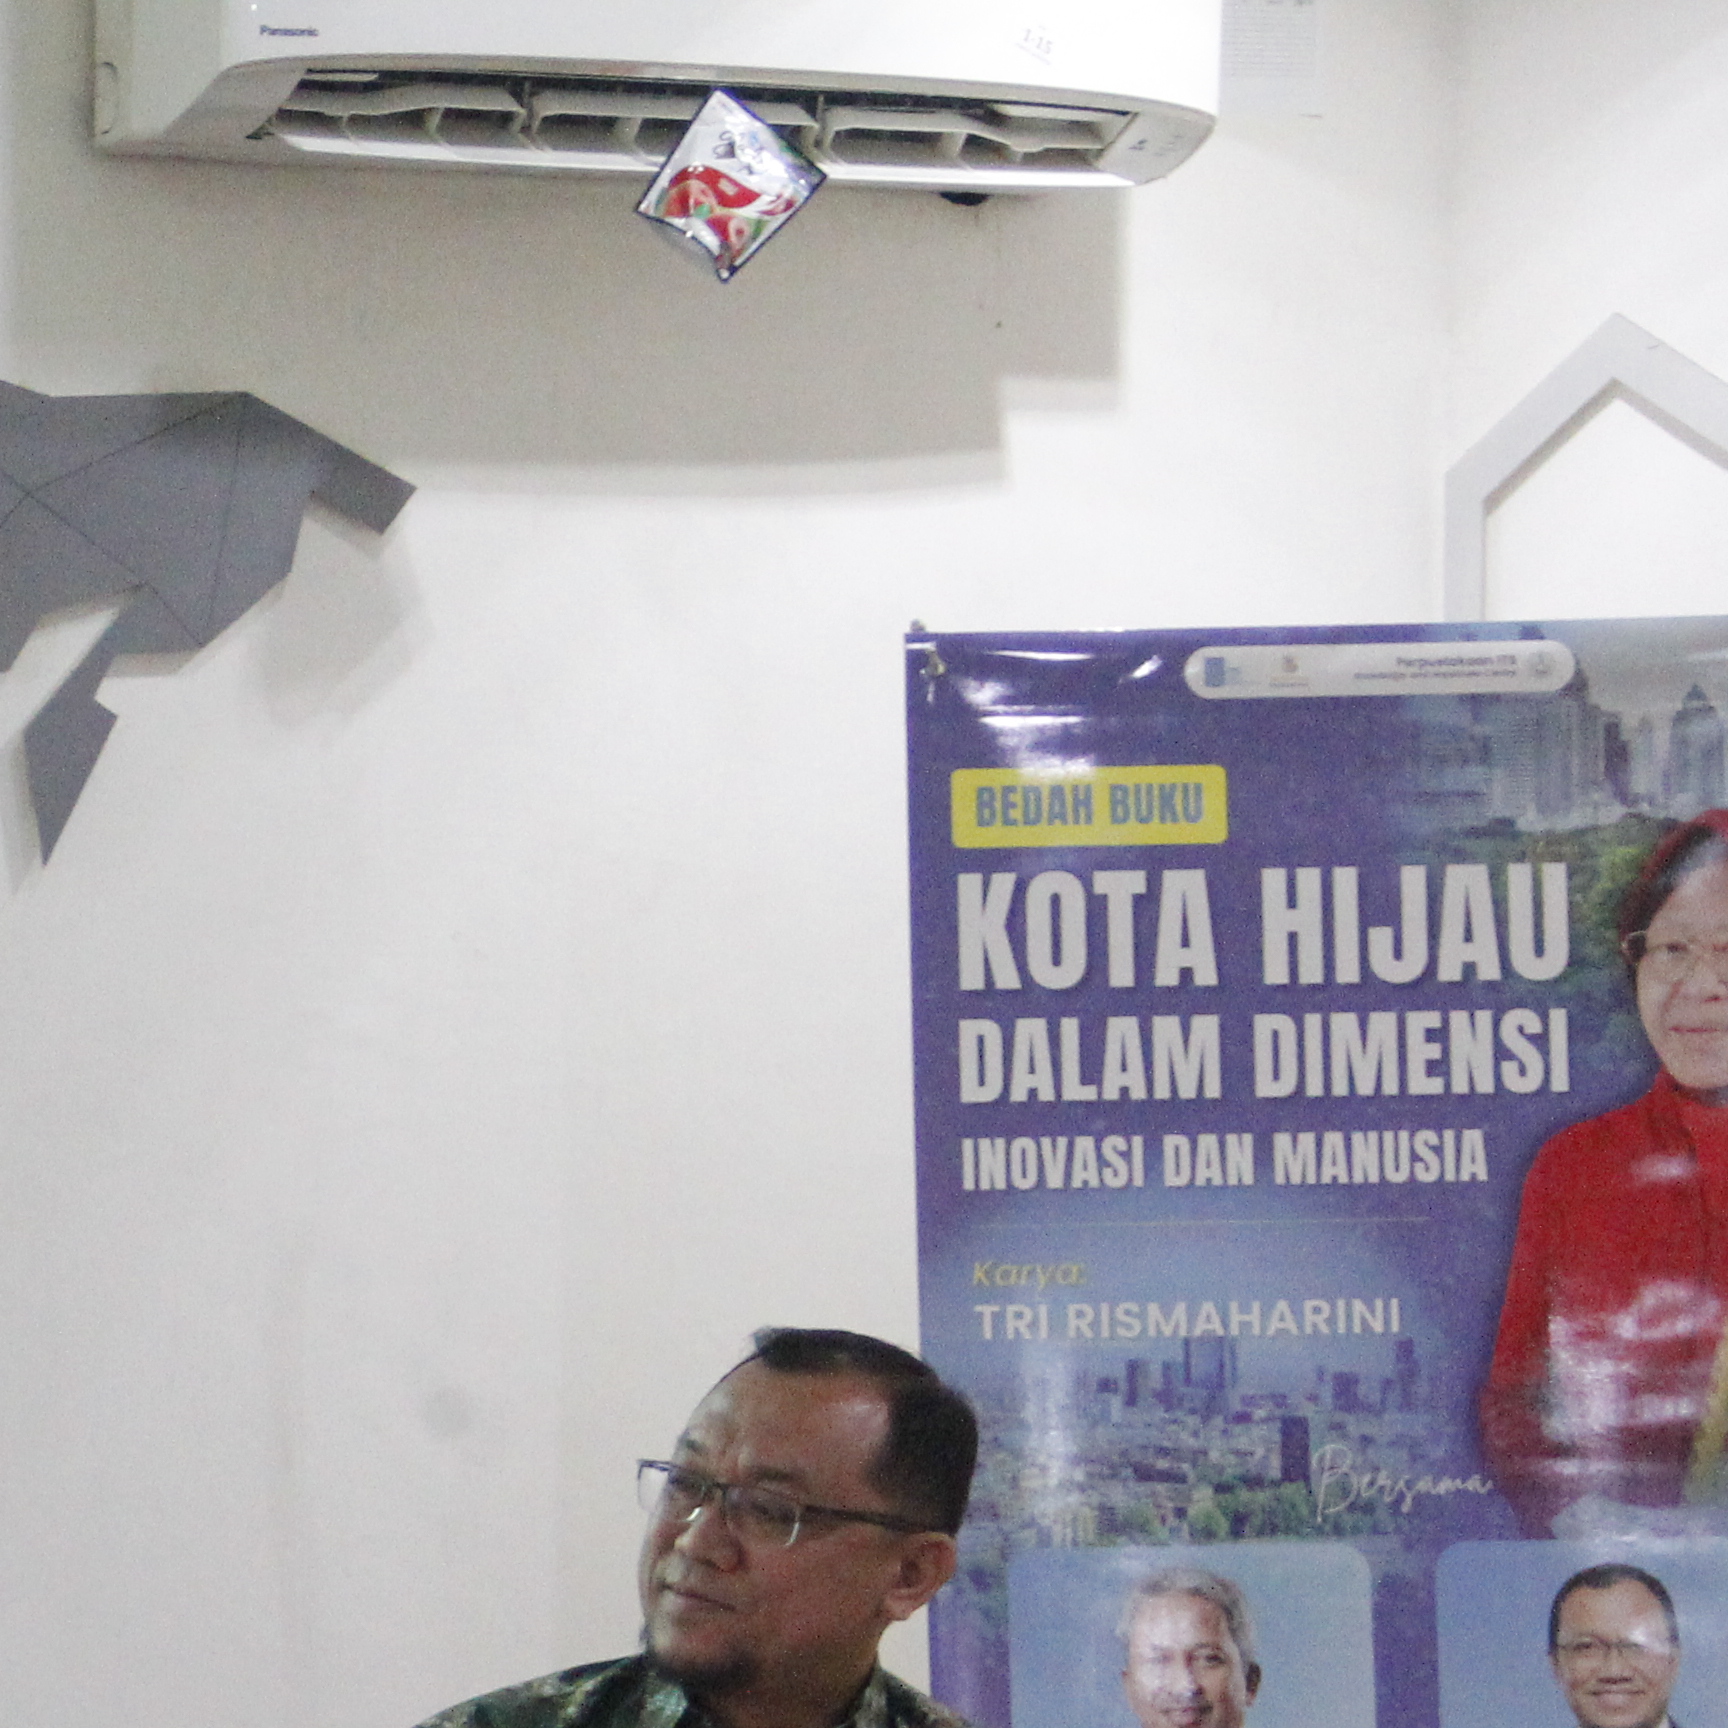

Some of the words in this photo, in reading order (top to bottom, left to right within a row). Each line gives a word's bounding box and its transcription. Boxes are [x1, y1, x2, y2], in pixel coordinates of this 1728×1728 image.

[976, 784, 1093, 827] BEDAH
[1109, 782, 1204, 825] BUKU
[957, 868, 1219, 991] KOTA
[1261, 862, 1571, 985] HIJAU
[958, 1014, 1222, 1104] DALAM
[1253, 1008, 1571, 1098] DIMENSI
[961, 1135, 1143, 1191] INOVASI
[1162, 1132, 1255, 1187] DAN
[1272, 1129, 1489, 1185] MANUSIA
[974, 1303, 1049, 1340] TRI
[1067, 1298, 1401, 1338] RISMAHARINI
